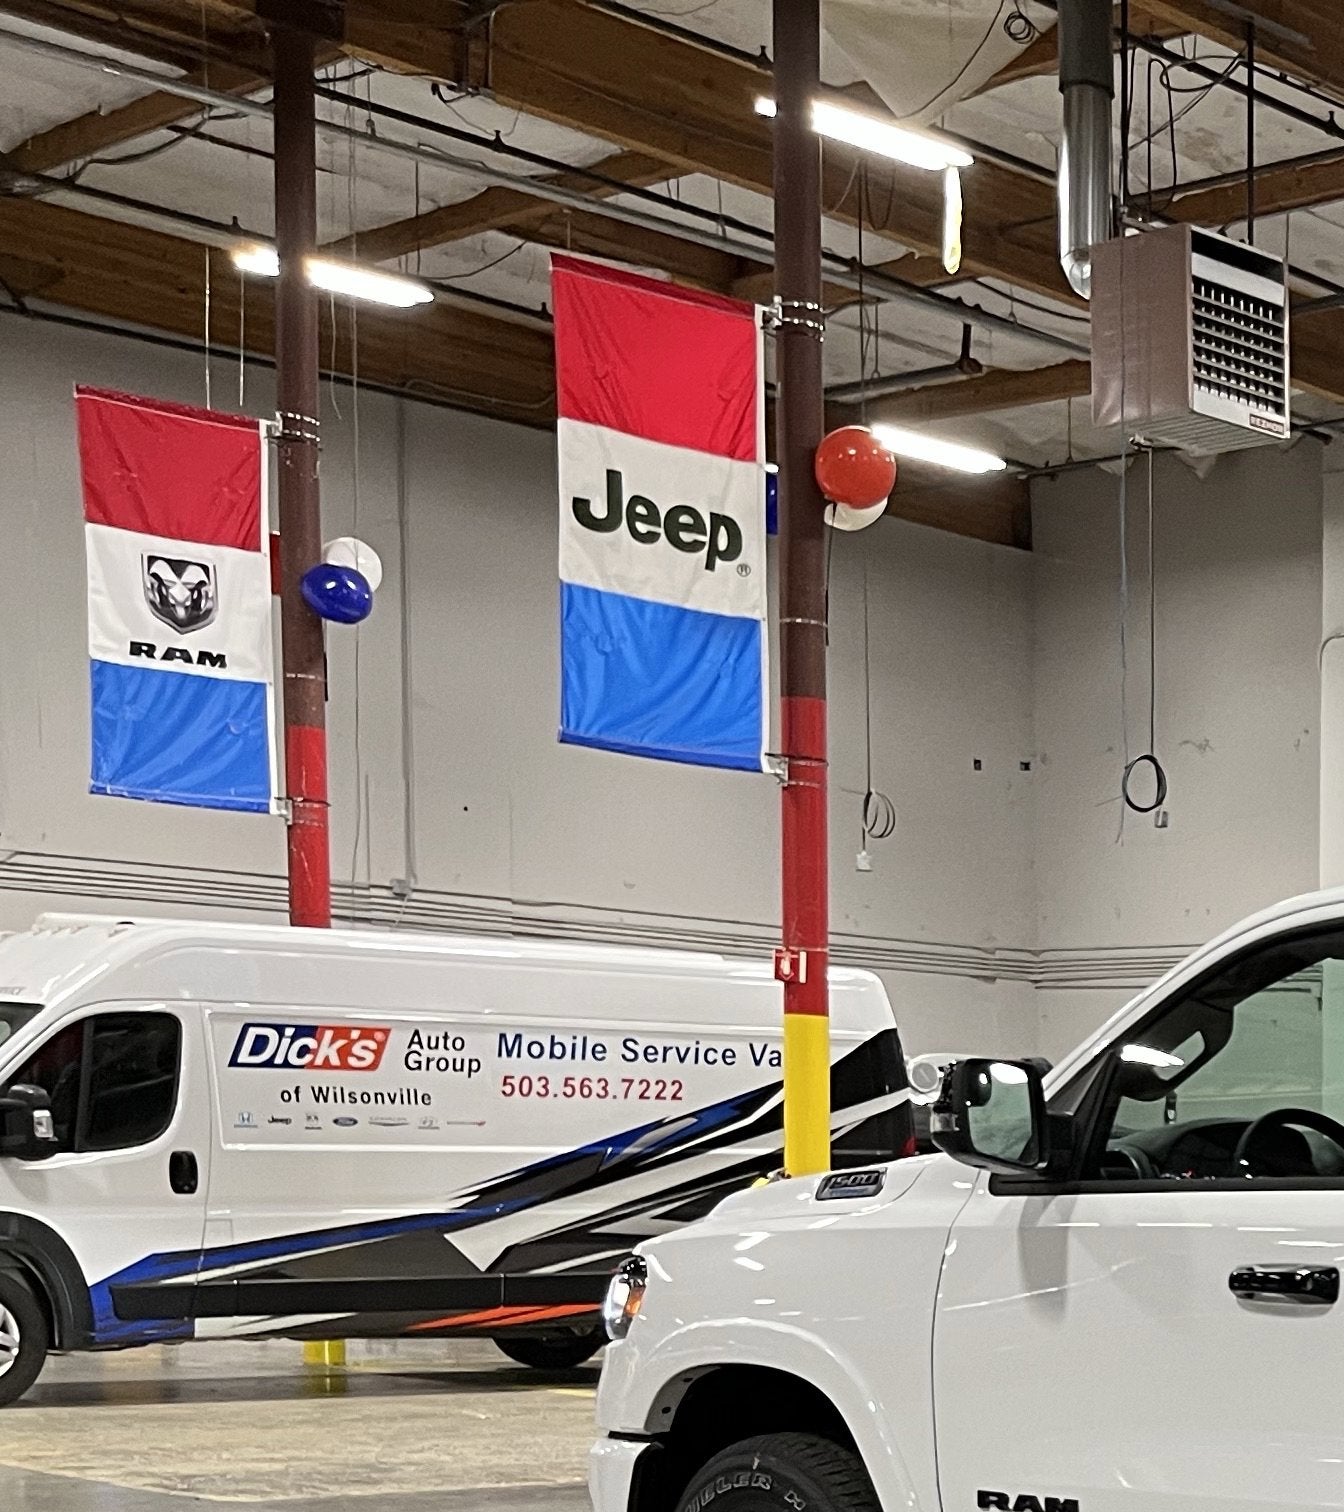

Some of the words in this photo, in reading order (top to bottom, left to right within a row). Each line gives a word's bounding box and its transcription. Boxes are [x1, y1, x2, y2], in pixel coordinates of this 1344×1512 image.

[572, 469, 742, 572] Jeep
[129, 641, 228, 669] RAM
[407, 1029, 465, 1051] Auto
[497, 1033, 608, 1061] Mobile
[621, 1038, 737, 1065] Service
[749, 1043, 783, 1067] Va
[404, 1050, 481, 1078] Group
[501, 1075, 684, 1101] 503.563.7222
[280, 1086, 301, 1103] of
[311, 1085, 432, 1106] Wilsonville
[823, 1173, 879, 1192] 1500
